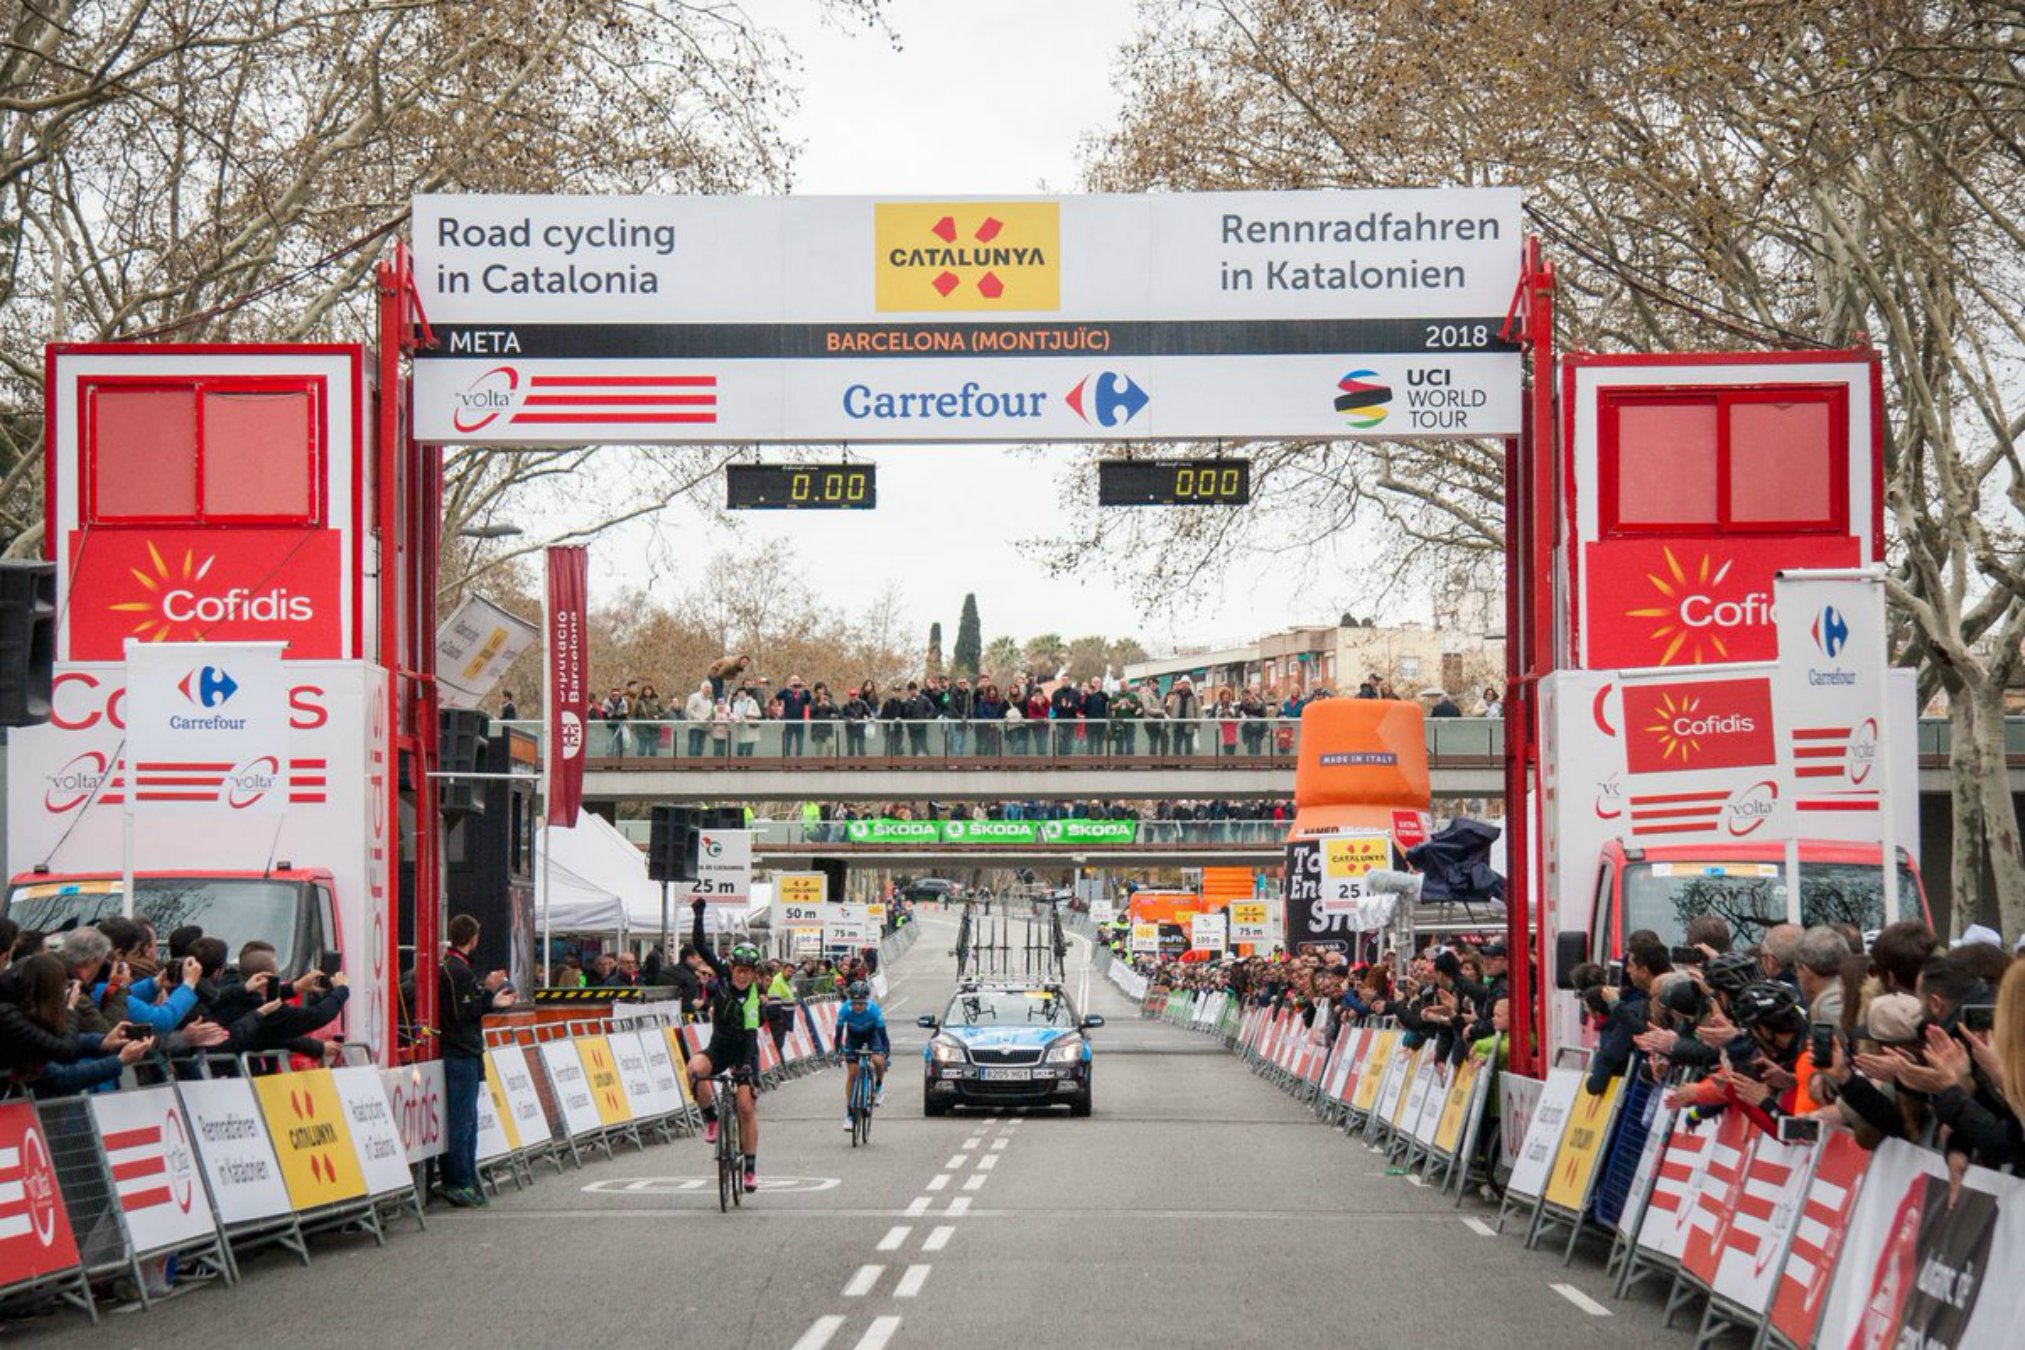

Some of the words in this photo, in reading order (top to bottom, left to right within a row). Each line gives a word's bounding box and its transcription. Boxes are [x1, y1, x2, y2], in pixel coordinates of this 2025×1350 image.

[437, 218, 531, 248] Road
[542, 217, 676, 255] cycling
[1220, 212, 1500, 244] Rennradfahren
[889, 248, 1045, 268] CATALUNYA
[437, 264, 470, 295] in
[481, 263, 660, 295] Catalonia
[1220, 261, 1254, 291] in
[1266, 259, 1466, 291] Katalonien
[449, 331, 522, 354] META
[826, 331, 966, 351] BARCELONA
[970, 328, 1111, 352] (MONTJUÏC)
[1425, 325, 1489, 348] 2018
[1407, 368, 1451, 387] UCI
[842, 382, 1048, 420] Carrefour
[1407, 388, 1487, 409] WORLD
[1409, 410, 1468, 429] TOUR
[162, 588, 314, 623] Cofidis
[1679, 593, 1777, 628] Cofi
[568, 610, 580, 703] Barcelona
[1808, 668, 1857, 687] Carrefour
[169, 715, 247, 731] Carrefour
[1672, 714, 1755, 737] Cofidis
[1322, 755, 1349, 764] MADE
[1351, 755, 1363, 764] IN
[1366, 755, 1394, 764] ITALY
[872, 820, 936, 837] ŠKODA
[968, 820, 1032, 837] ŠKODA
[1067, 821, 1131, 837] ŠKODA
[1331, 854, 1386, 863] CATALUNYA
[691, 878, 714, 894] 25
[718, 882, 735, 894] m
[1338, 884, 1361, 899] 25
[785, 907, 802, 920] 50
[803, 909, 817, 920] m
[834, 929, 847, 938] 75
[1239, 927, 1251, 936] 75
[1253, 928, 1264, 936] m
